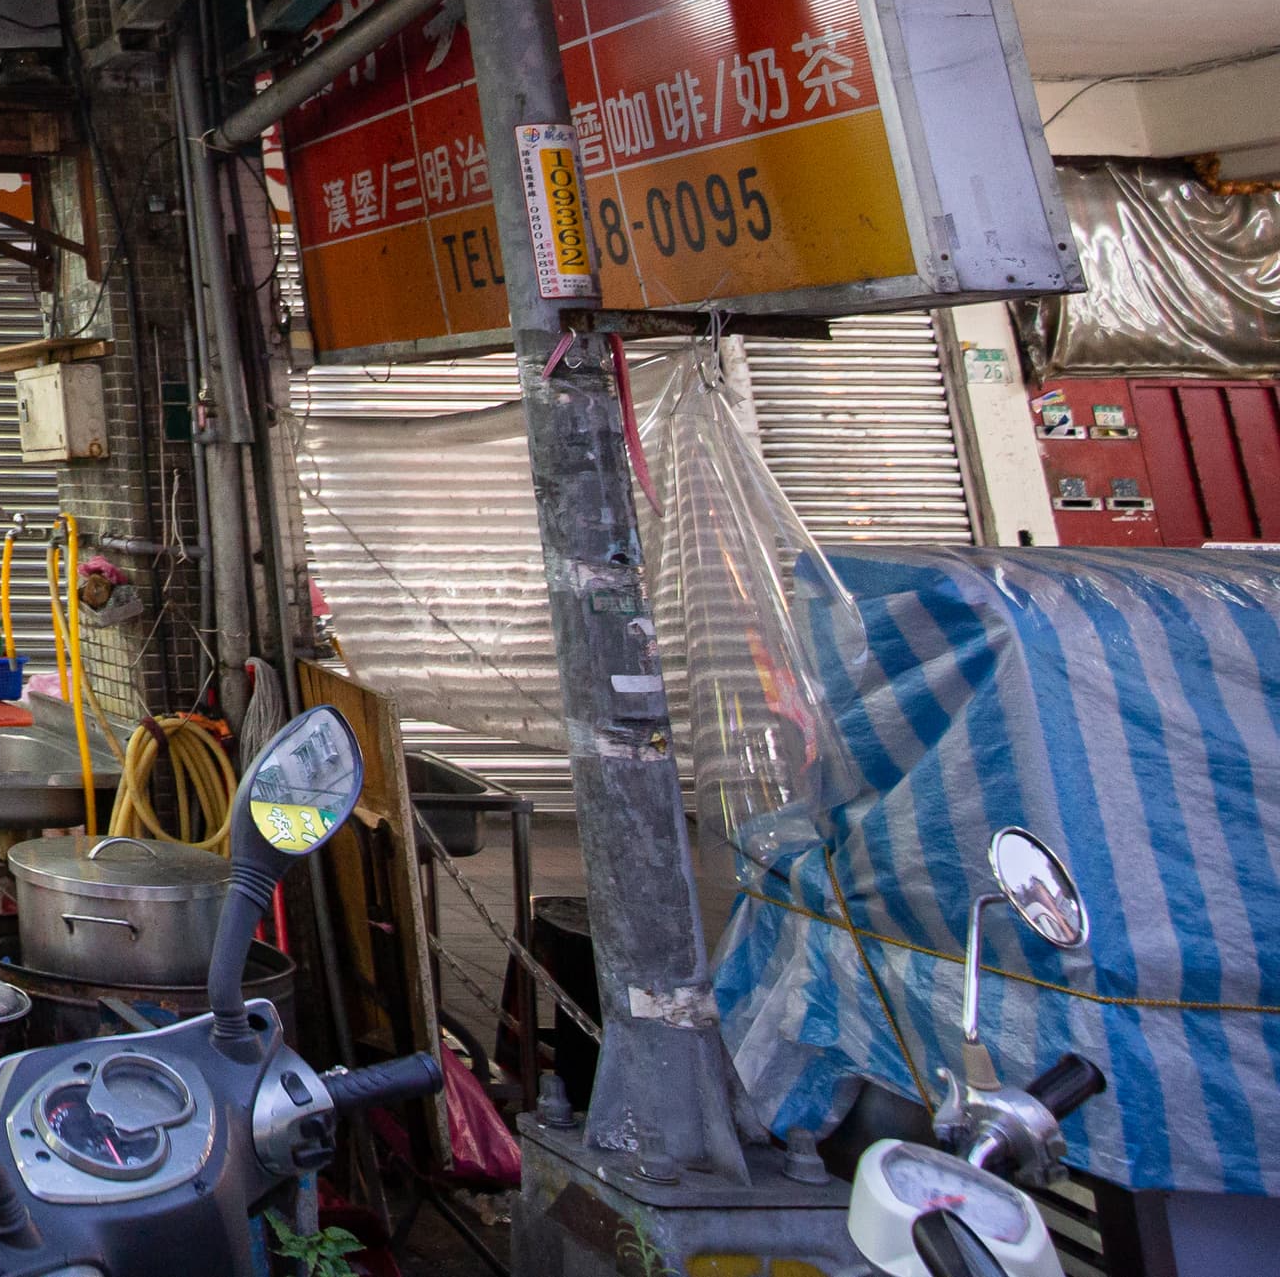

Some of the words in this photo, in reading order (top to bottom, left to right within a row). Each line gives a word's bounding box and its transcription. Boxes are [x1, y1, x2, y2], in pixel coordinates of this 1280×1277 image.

[321, 133, 491, 234] 漢堡/三明治
[550, 150, 585, 267] 109362
[596, 166, 772, 269] 8-0095
